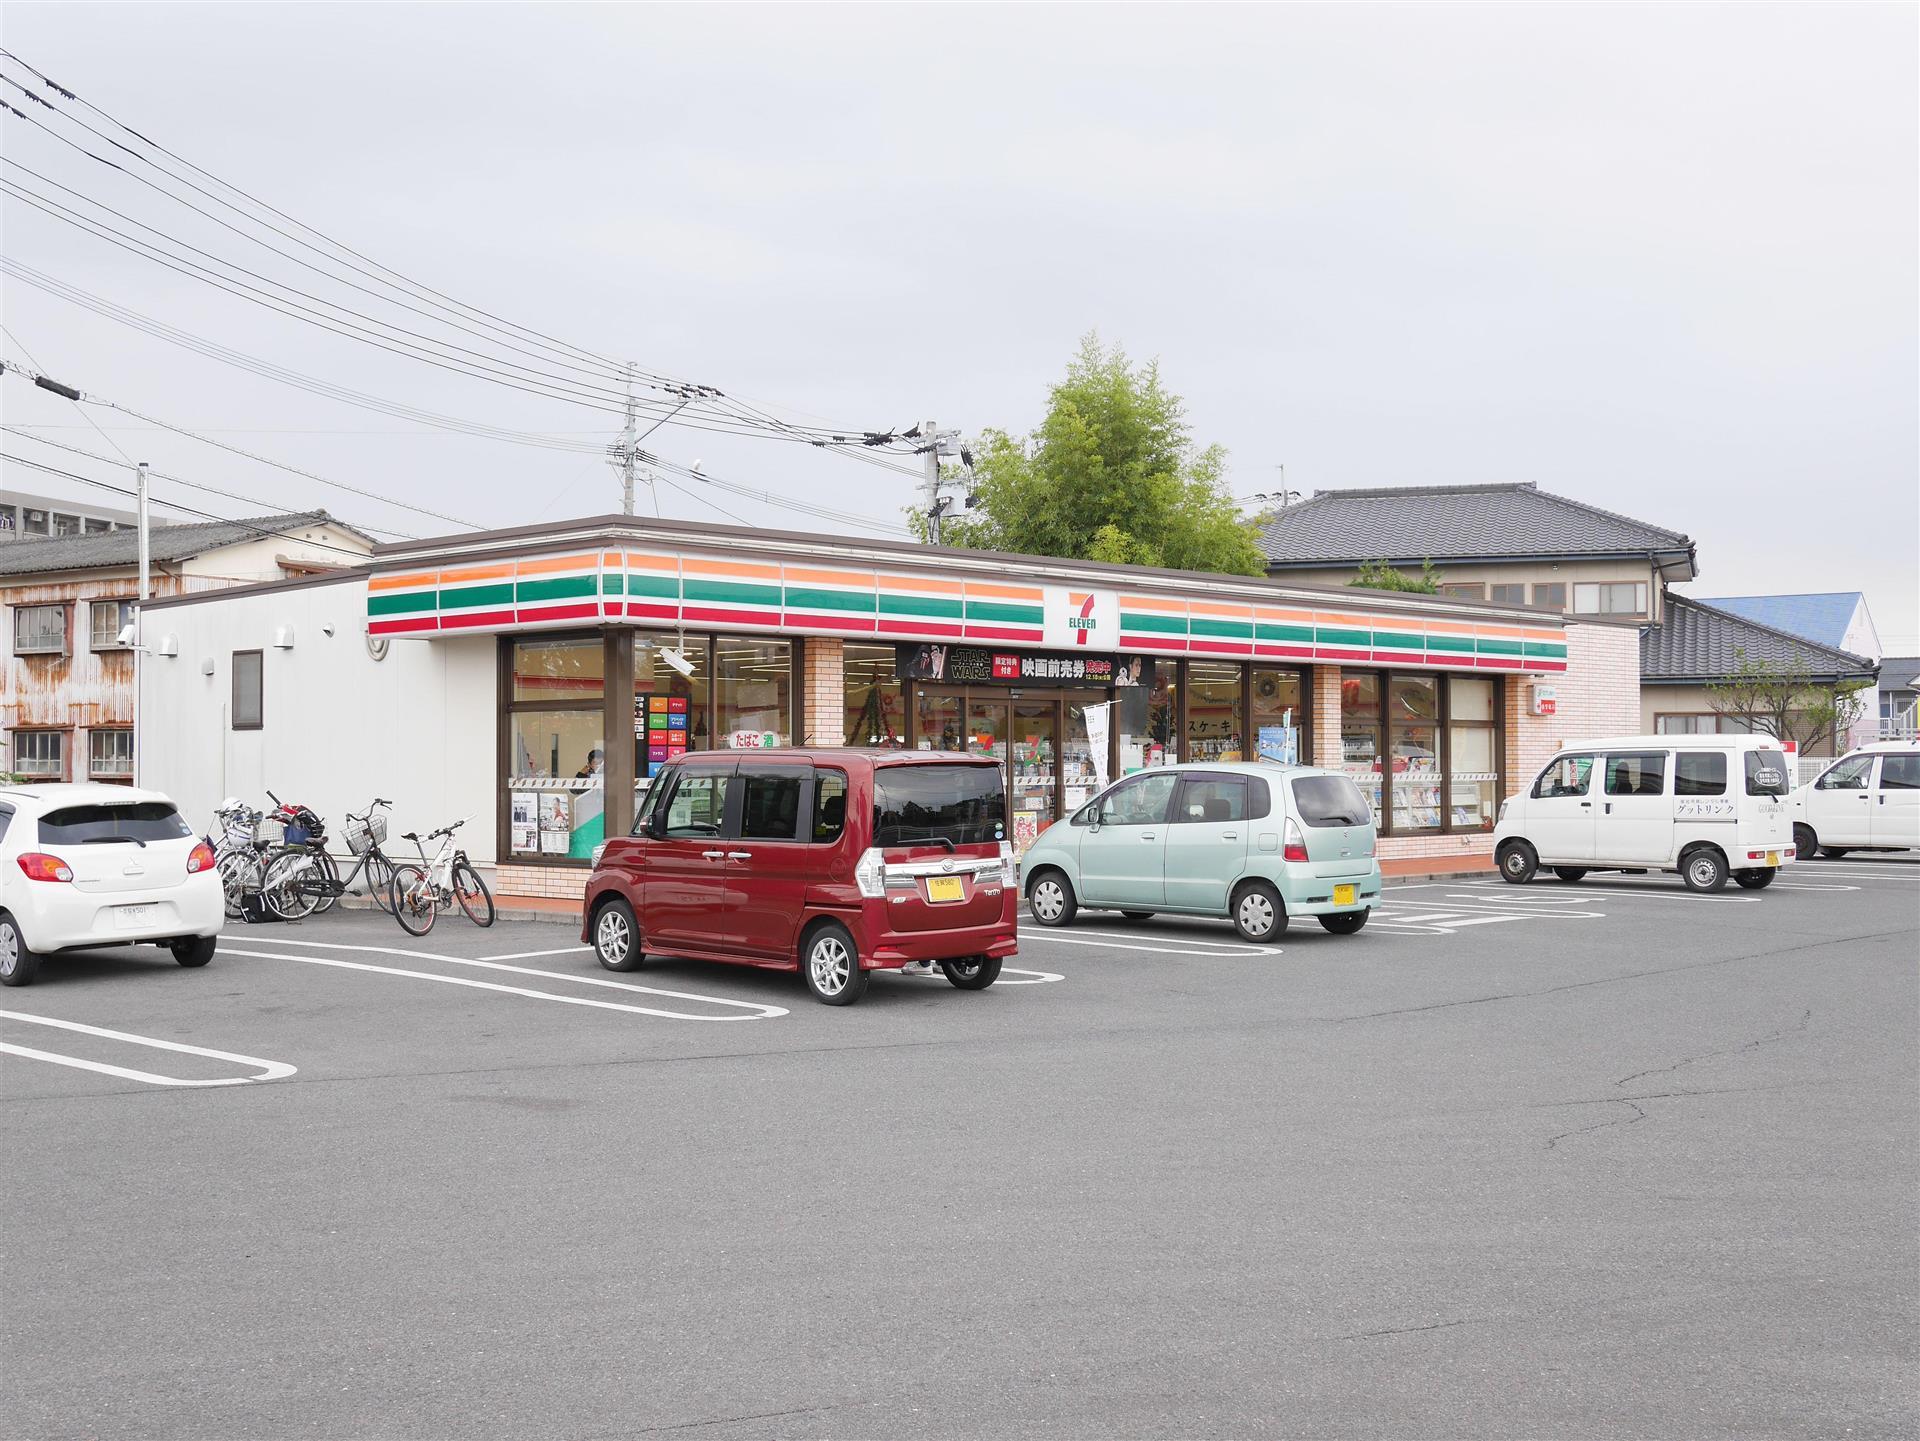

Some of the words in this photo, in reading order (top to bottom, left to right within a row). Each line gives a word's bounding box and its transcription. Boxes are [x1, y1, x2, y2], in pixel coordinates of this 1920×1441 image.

[951, 648, 991, 663] STAR
[951, 664, 990, 680] WARS
[1021, 657, 1085, 678] 映画前売券
[1085, 659, 1112, 674] 発売中
[736, 734, 759, 747] たばこ
[763, 734, 774, 748] 酒
